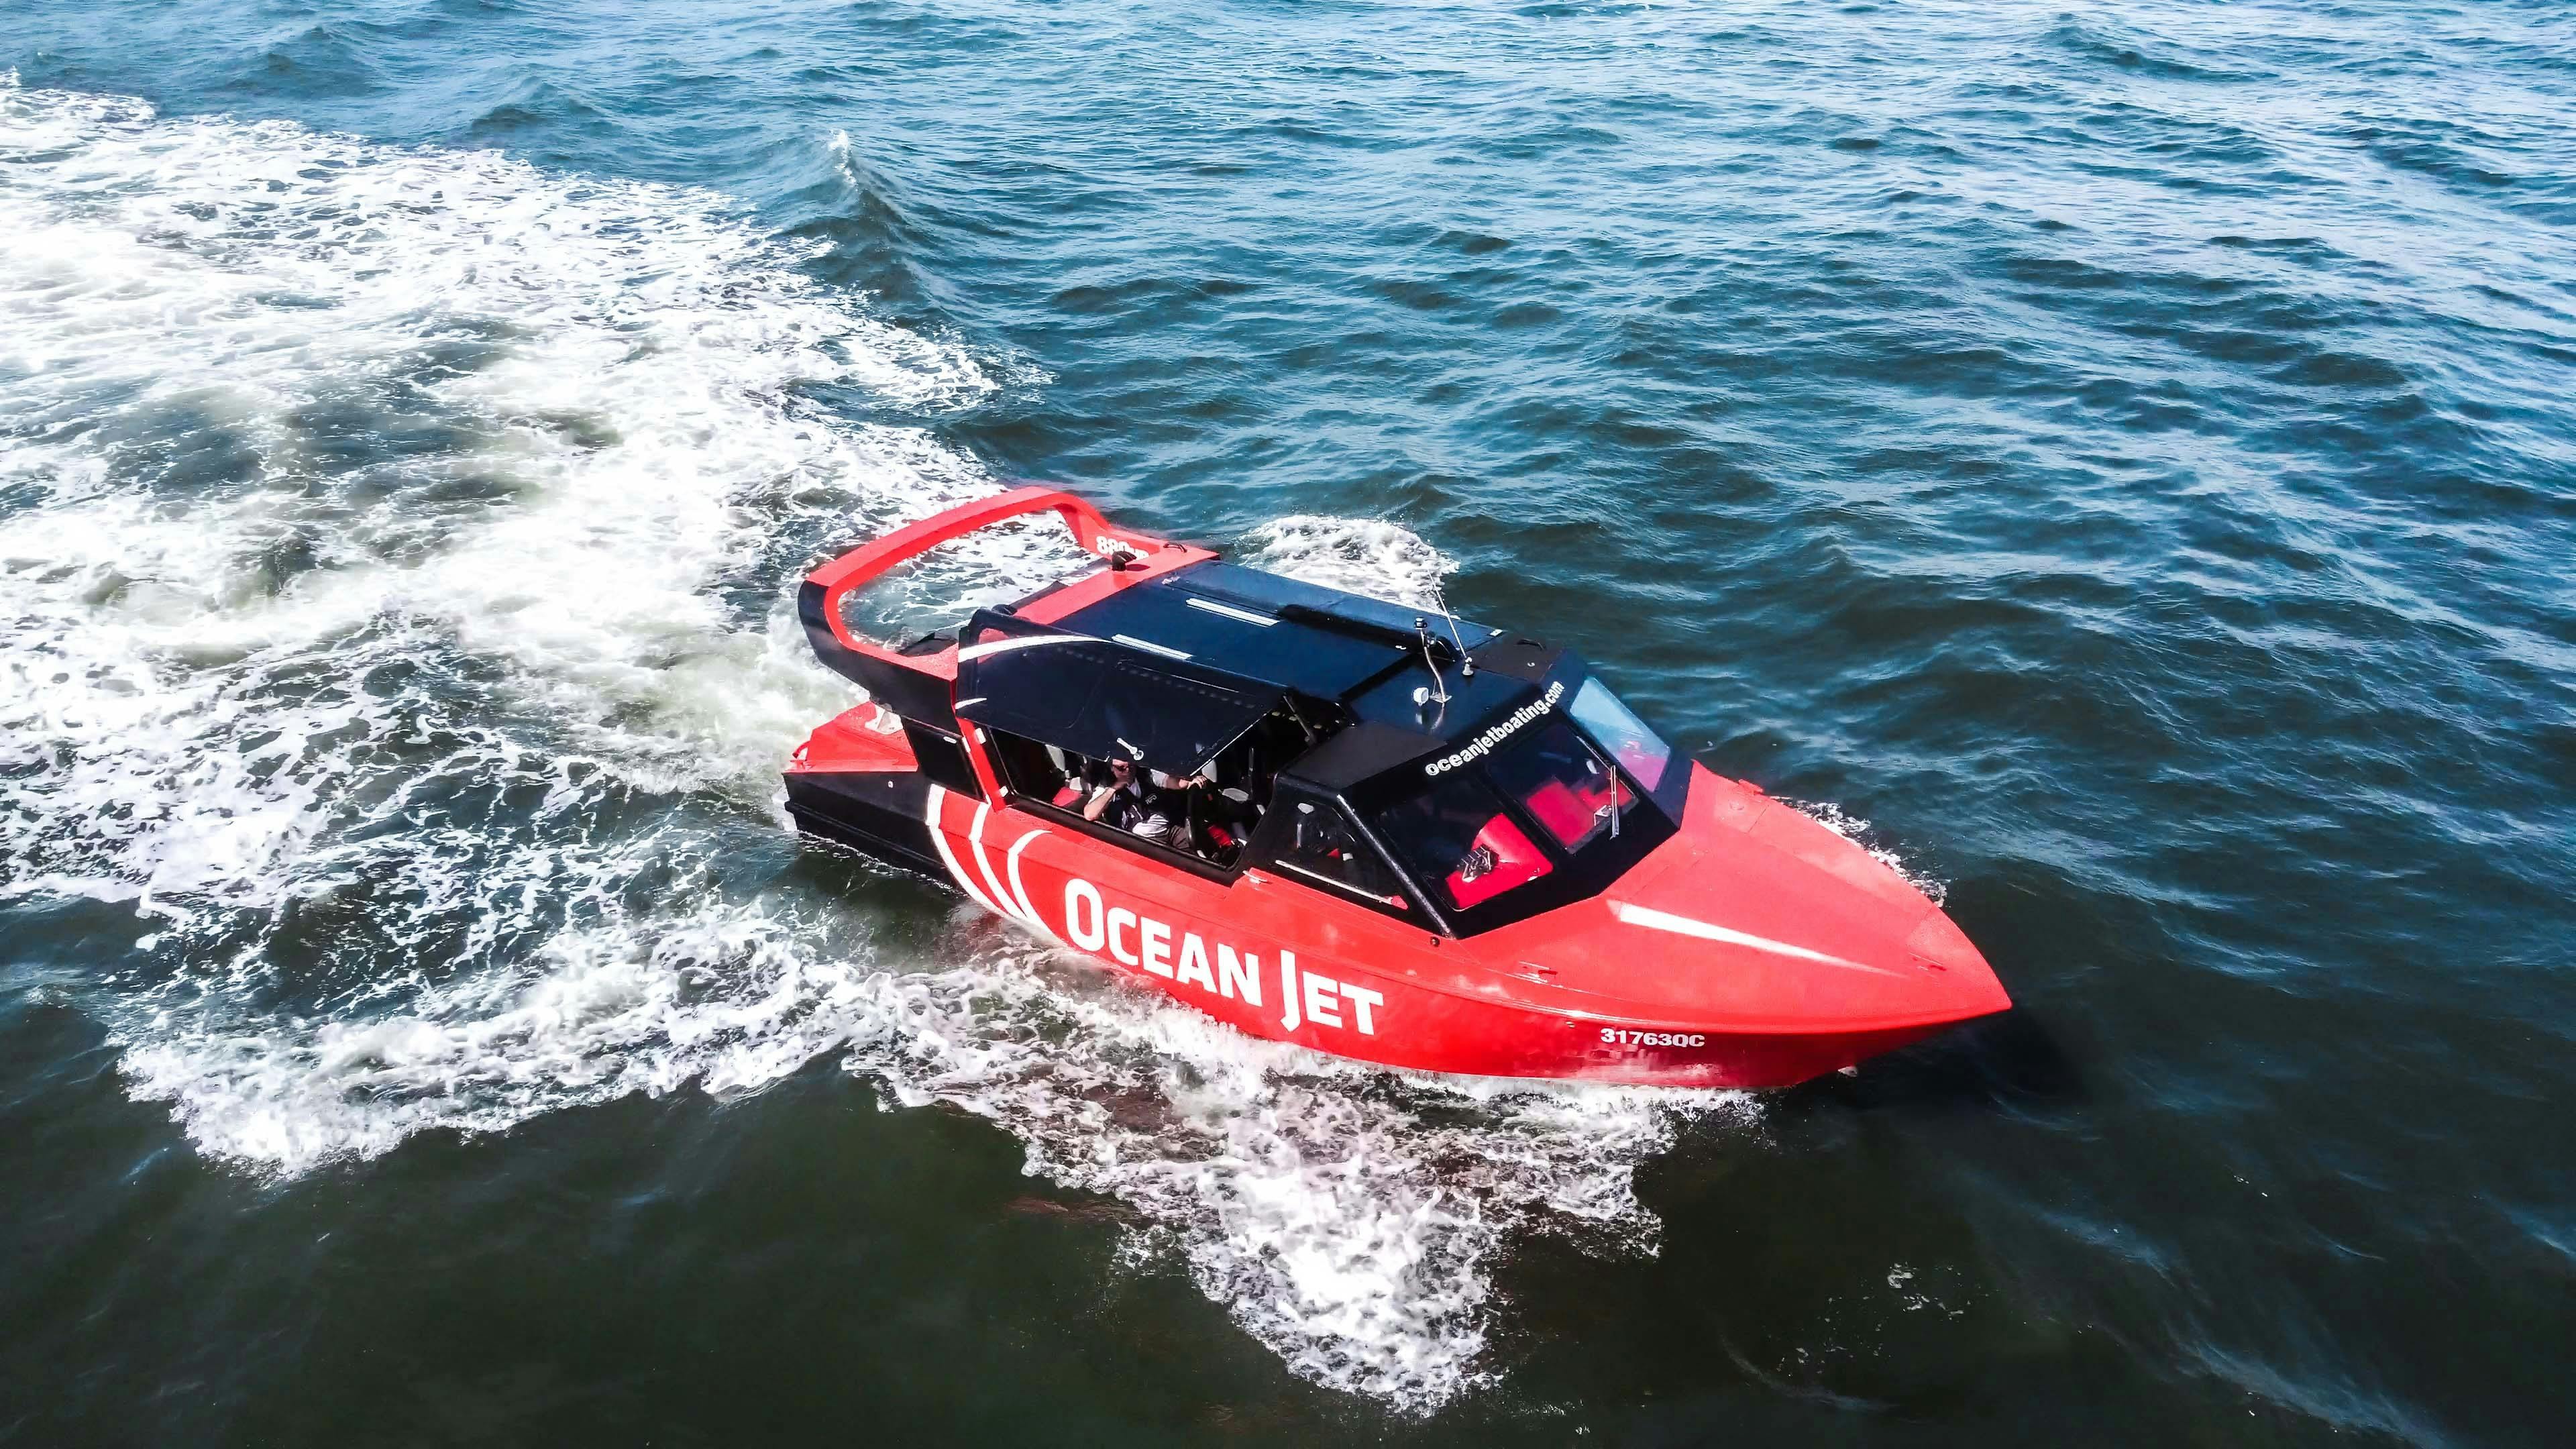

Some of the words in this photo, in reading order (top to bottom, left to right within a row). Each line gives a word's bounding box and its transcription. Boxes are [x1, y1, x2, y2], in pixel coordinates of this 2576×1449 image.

[1425, 681, 1565, 775] oceanjetboating.com
[1064, 878, 1263, 1007] OCEAN
[1280, 949, 1384, 1036] JET
[1600, 1028, 1705, 1047] 31763QC
